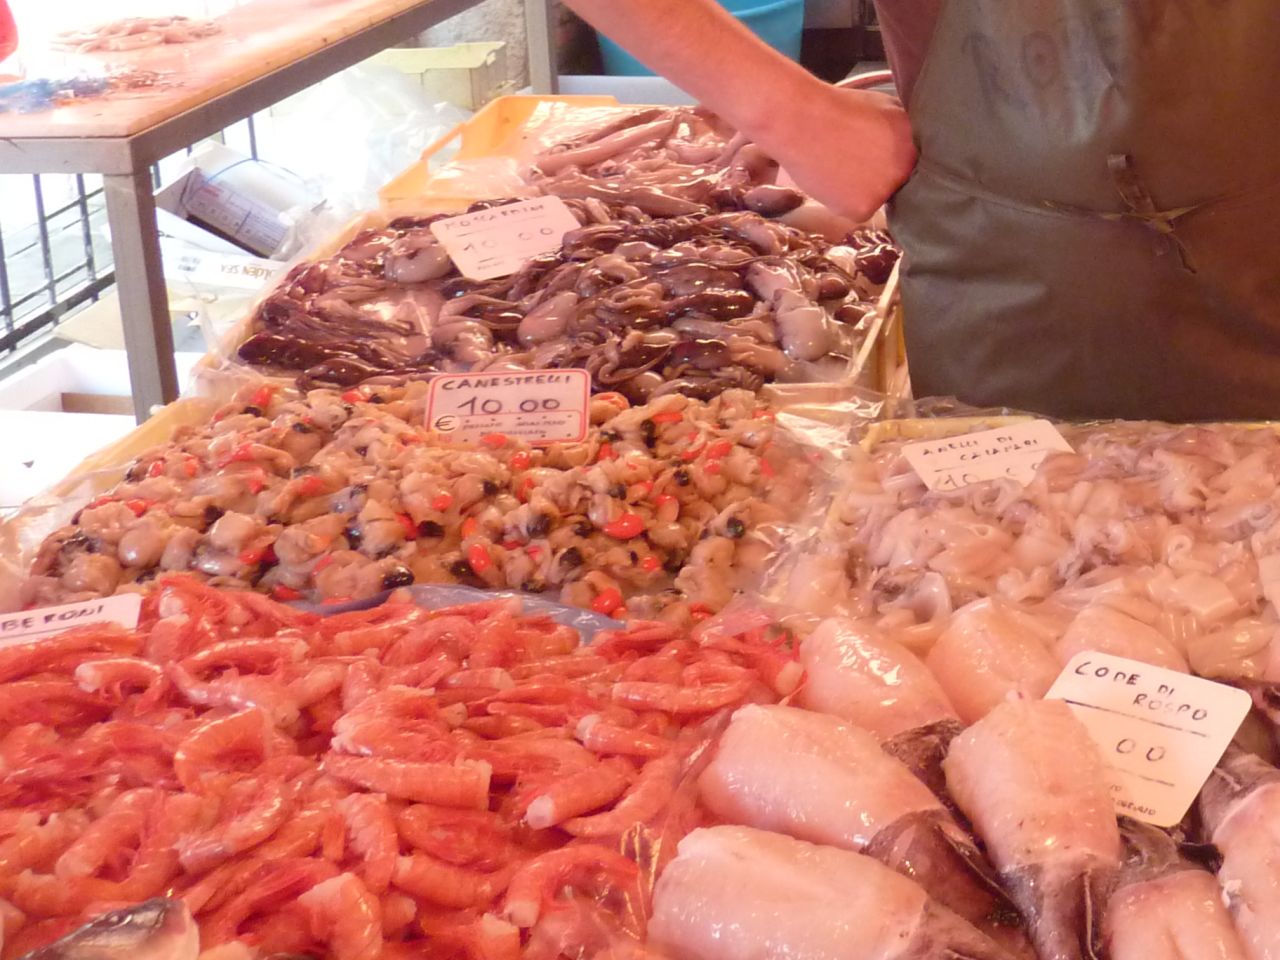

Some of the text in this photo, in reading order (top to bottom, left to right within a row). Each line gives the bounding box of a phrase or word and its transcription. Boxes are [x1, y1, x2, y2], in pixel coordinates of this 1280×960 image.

[441, 375, 572, 391] CANESTRELLI
[1074, 660, 1142, 686] CODE
[1132, 692, 1208, 722] ROSPO
